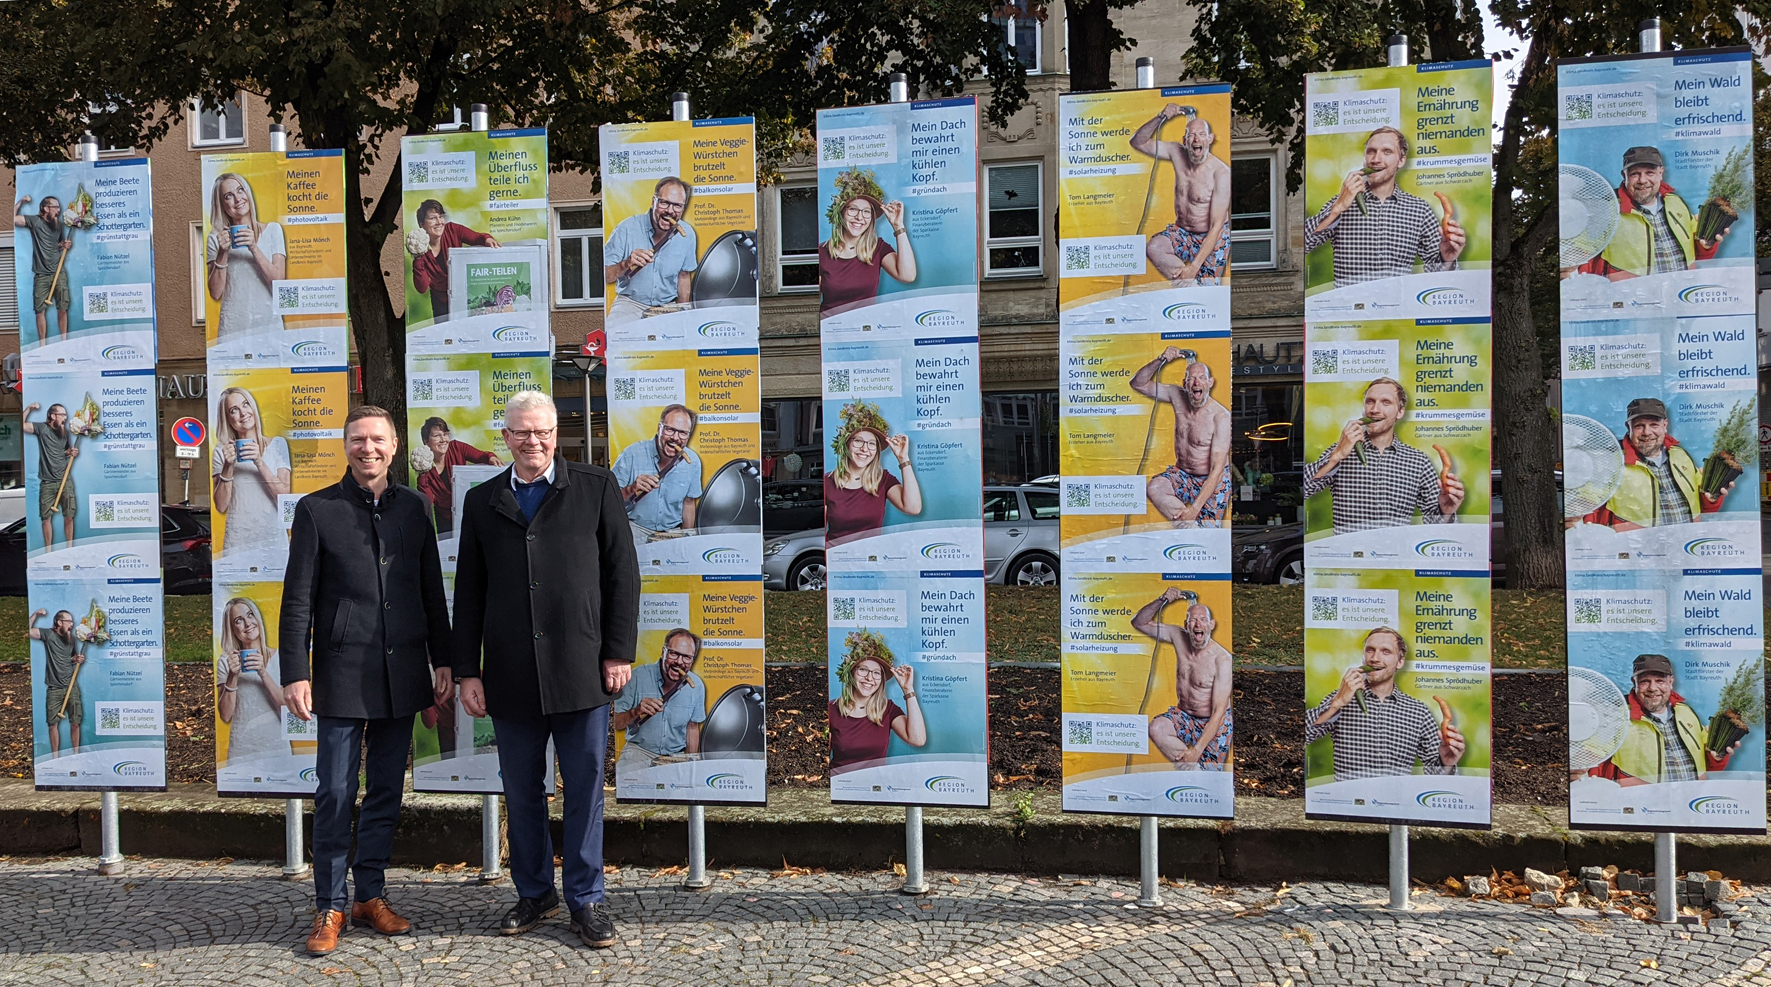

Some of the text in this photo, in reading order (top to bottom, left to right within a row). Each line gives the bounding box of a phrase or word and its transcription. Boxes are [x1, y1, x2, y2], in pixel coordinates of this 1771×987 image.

[1674, 75, 1740, 90] Mein Wald
[1417, 86, 1455, 99] Meine
[1344, 98, 1387, 106] Klimaschutz:
[1418, 97, 1479, 114] Ernährung
[1675, 96, 1709, 108] bleibt
[1069, 116, 1103, 126] Mit der
[1343, 116, 1391, 127] Entscheidung.
[1417, 113, 1455, 131] grenzt
[1675, 110, 1746, 125] erfrischend.
[911, 119, 966, 132] Mein Dach
[1069, 127, 1130, 139] Sonne werde
[1417, 126, 1484, 140] niemanden
[1675, 127, 1721, 137] #klimawald
[693, 137, 749, 148] Meine Veggie-
[912, 133, 954, 145] bewahrt
[912, 146, 960, 157] mir einen
[1069, 142, 1081, 151] ich
[1417, 145, 1439, 154] aus.
[488, 150, 527, 162] Meinen
[693, 150, 738, 159] Würstchen
[1069, 153, 1131, 164] Warmduscher.
[489, 160, 538, 174] Überfluss
[694, 162, 725, 171] brutzelt
[912, 159, 946, 170] kühlen
[1416, 156, 1487, 168] #krummesgemüse
[287, 170, 320, 178] Meinen
[1068, 166, 1116, 175] #solarheizung
[95, 178, 118, 187] Meine
[488, 174, 528, 185] teile ich
[694, 174, 736, 184] die Sonne.
[912, 172, 937, 184] Kopf.
[287, 180, 316, 190] Kaffee
[95, 189, 137, 200] produzieren
[489, 189, 521, 201] gerne.
[912, 185, 947, 196] #gründach
[287, 192, 328, 201] kocht die
[95, 200, 126, 209] besseres
[287, 205, 317, 213] Sonne.
[489, 201, 519, 210] #fairteiler
[288, 214, 328, 224] #photovoltaik
[96, 221, 146, 231] Schottergarten.
[96, 232, 138, 242] #grünstattgrau
[471, 267, 517, 278] FAIR-TEILEN
[1416, 339, 1454, 350] Meine
[916, 356, 969, 368] Mein Dach
[1416, 353, 1477, 368] Ernährung
[493, 370, 531, 381] Meinen
[916, 369, 958, 380] bewahrt
[1416, 368, 1453, 383] grenzt
[493, 381, 541, 392] Überfluss
[916, 382, 964, 392] mir einen
[1416, 380, 1483, 393] niemanden
[917, 394, 950, 404] kühlen
[1416, 398, 1438, 407] aus.
[917, 406, 942, 418] Kopf.
[1415, 411, 1485, 420] #krummesgemüse
[916, 421, 952, 429] #gründach
[1446, 425, 1482, 434] Sprödhuber
[1083, 432, 1115, 440] Langmeier
[1094, 500, 1138, 508] Entscheidung.
[108, 595, 131, 603] Meine
[729, 594, 758, 605] Veggie-
[1070, 594, 1104, 602] Mit der
[1684, 589, 1751, 600] Mein Wald
[109, 606, 150, 616] produzieren
[703, 604, 747, 613] Würstchen
[1070, 606, 1131, 616] Sonne werde
[1685, 607, 1719, 618] bleibt
[703, 616, 734, 624] brutzelt
[1070, 619, 1083, 629] ich
[1606, 617, 1658, 625] Entscheidung.
[130, 628, 140, 636] als
[703, 628, 745, 636] die Sonne.
[1685, 624, 1756, 635] erfrischend.
[1070, 631, 1134, 640] Warmduscher.
[109, 639, 158, 648] Schottergarten.
[1070, 644, 1118, 653] #solarheizung
[1684, 640, 1732, 649] #klimawald
